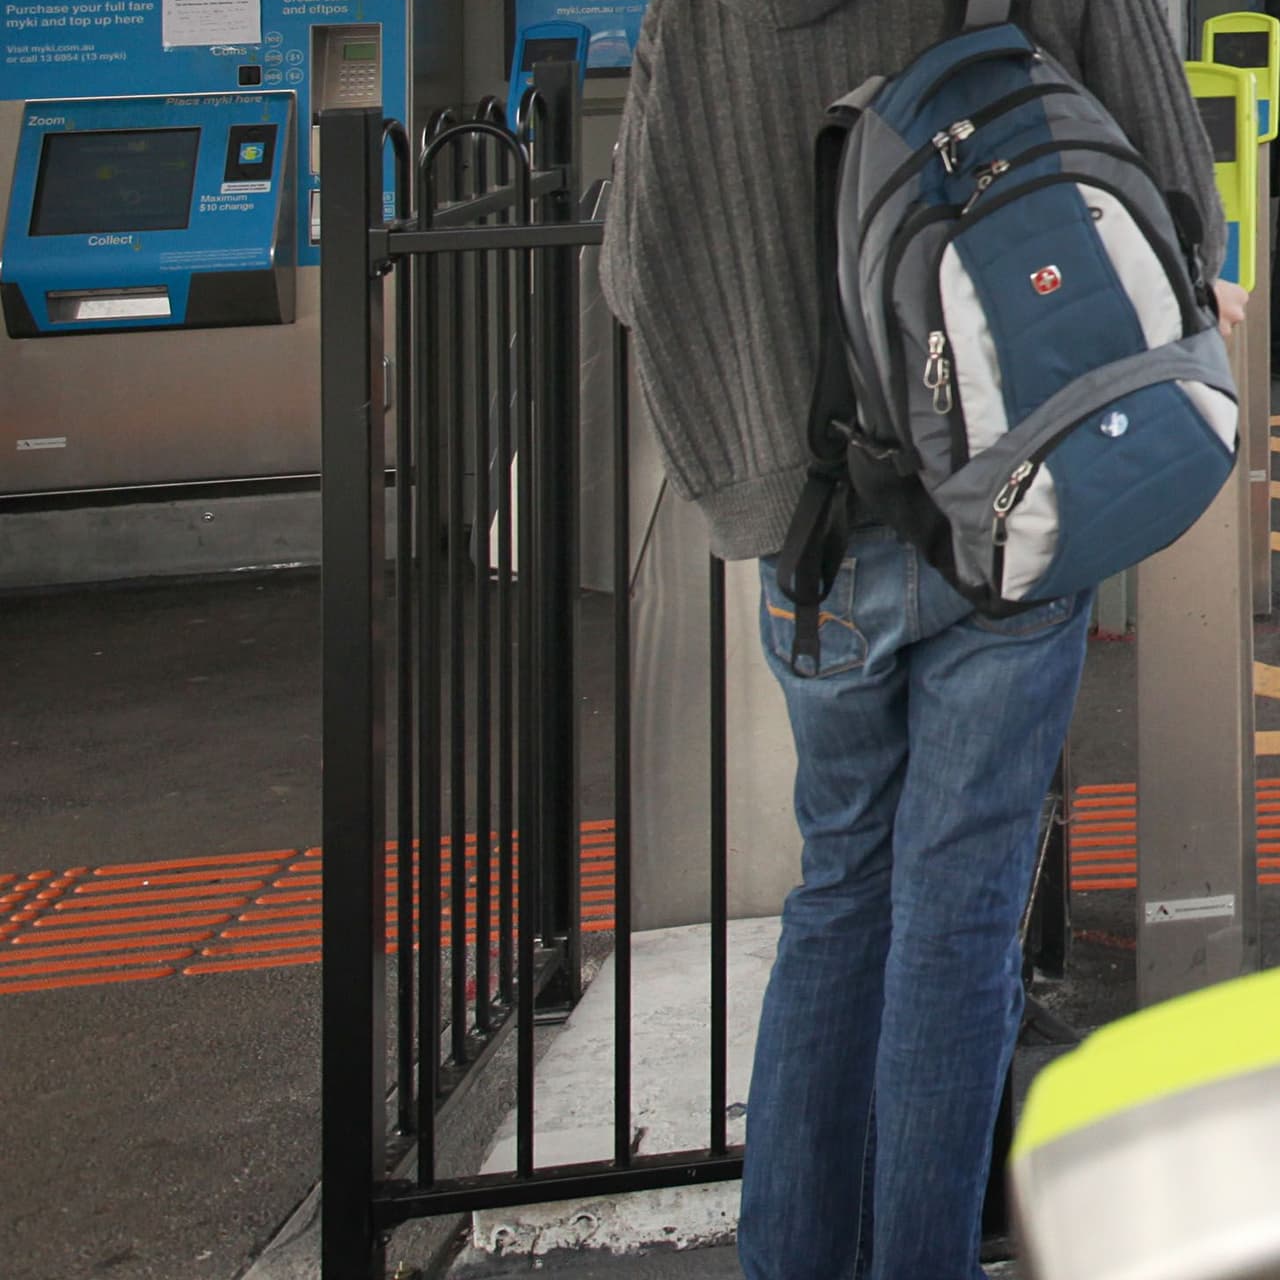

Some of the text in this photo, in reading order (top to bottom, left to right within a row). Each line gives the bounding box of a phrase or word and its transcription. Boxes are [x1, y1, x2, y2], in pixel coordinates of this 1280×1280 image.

[6, 1, 155, 16] Purchase your full fare
[282, 3, 348, 15] and eftpos
[6, 15, 145, 30] myki and top up here
[31, 44, 95, 55] myki.com.au
[212, 46, 248, 57] Coins
[203, 96, 233, 107] myki
[28, 115, 65, 127] Zoom
[200, 194, 248, 203] Maximum
[199, 202, 255, 212] $10 change
[88, 234, 133, 247] Collect
